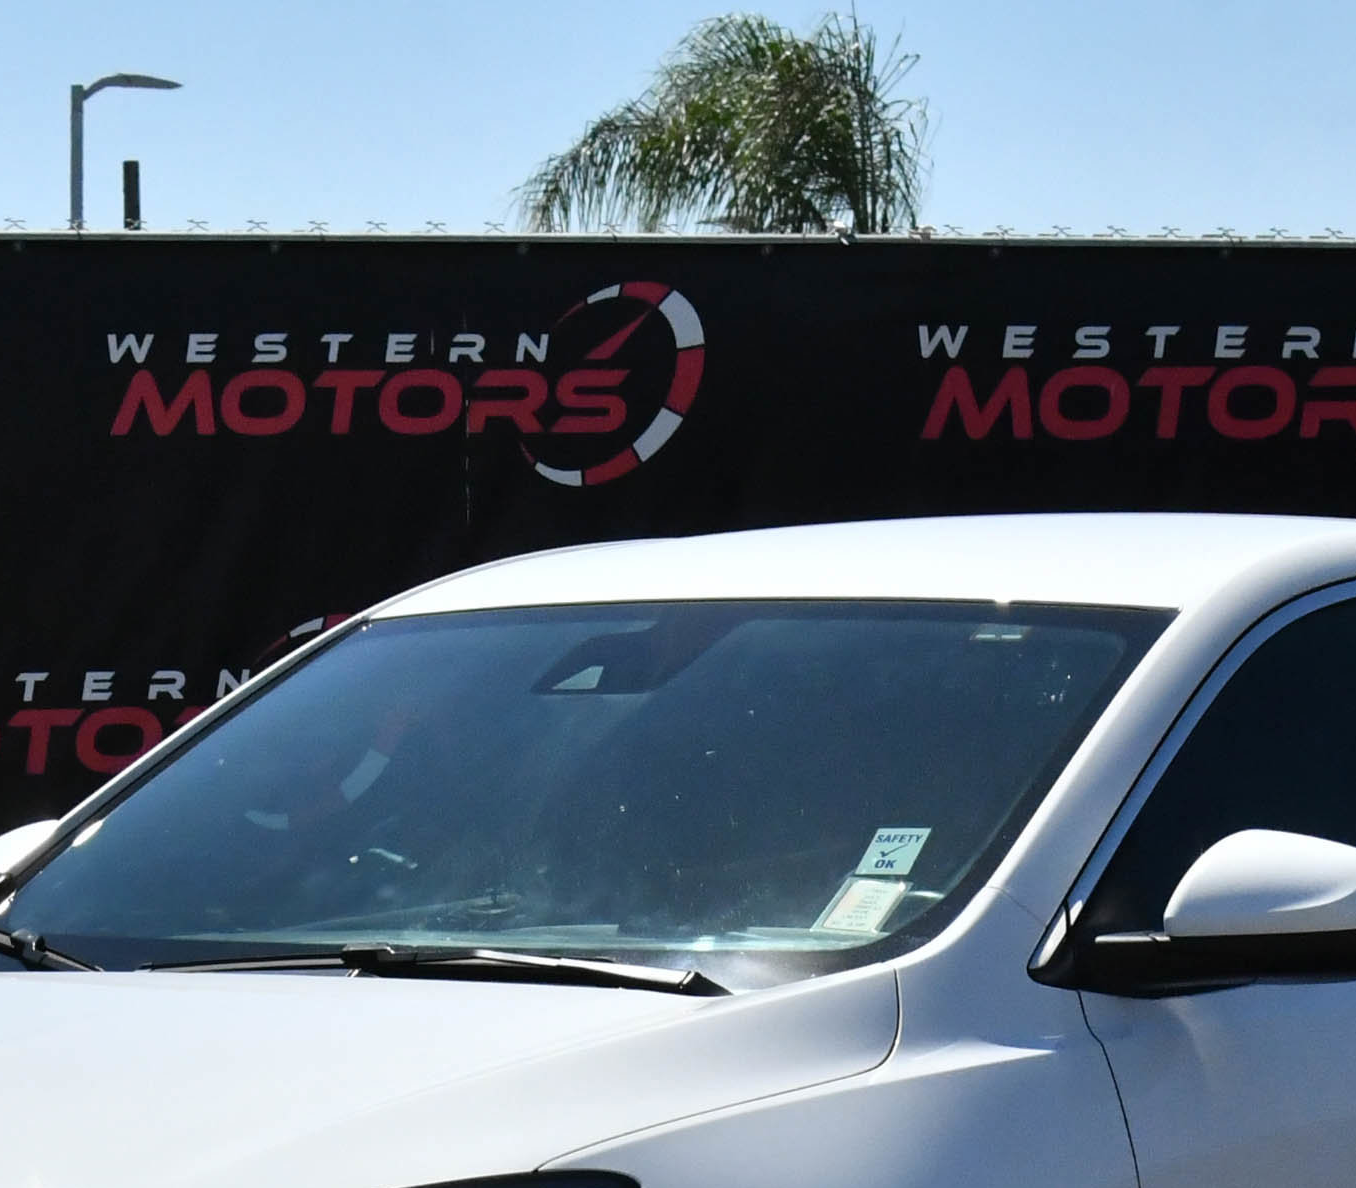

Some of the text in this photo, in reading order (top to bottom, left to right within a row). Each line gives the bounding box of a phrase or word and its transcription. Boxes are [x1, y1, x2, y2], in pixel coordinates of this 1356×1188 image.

[107, 333, 549, 364] WESTERN
[110, 368, 629, 436] MOTORS
[875, 834, 923, 843] SAFETY
[874, 859, 897, 869] OK
